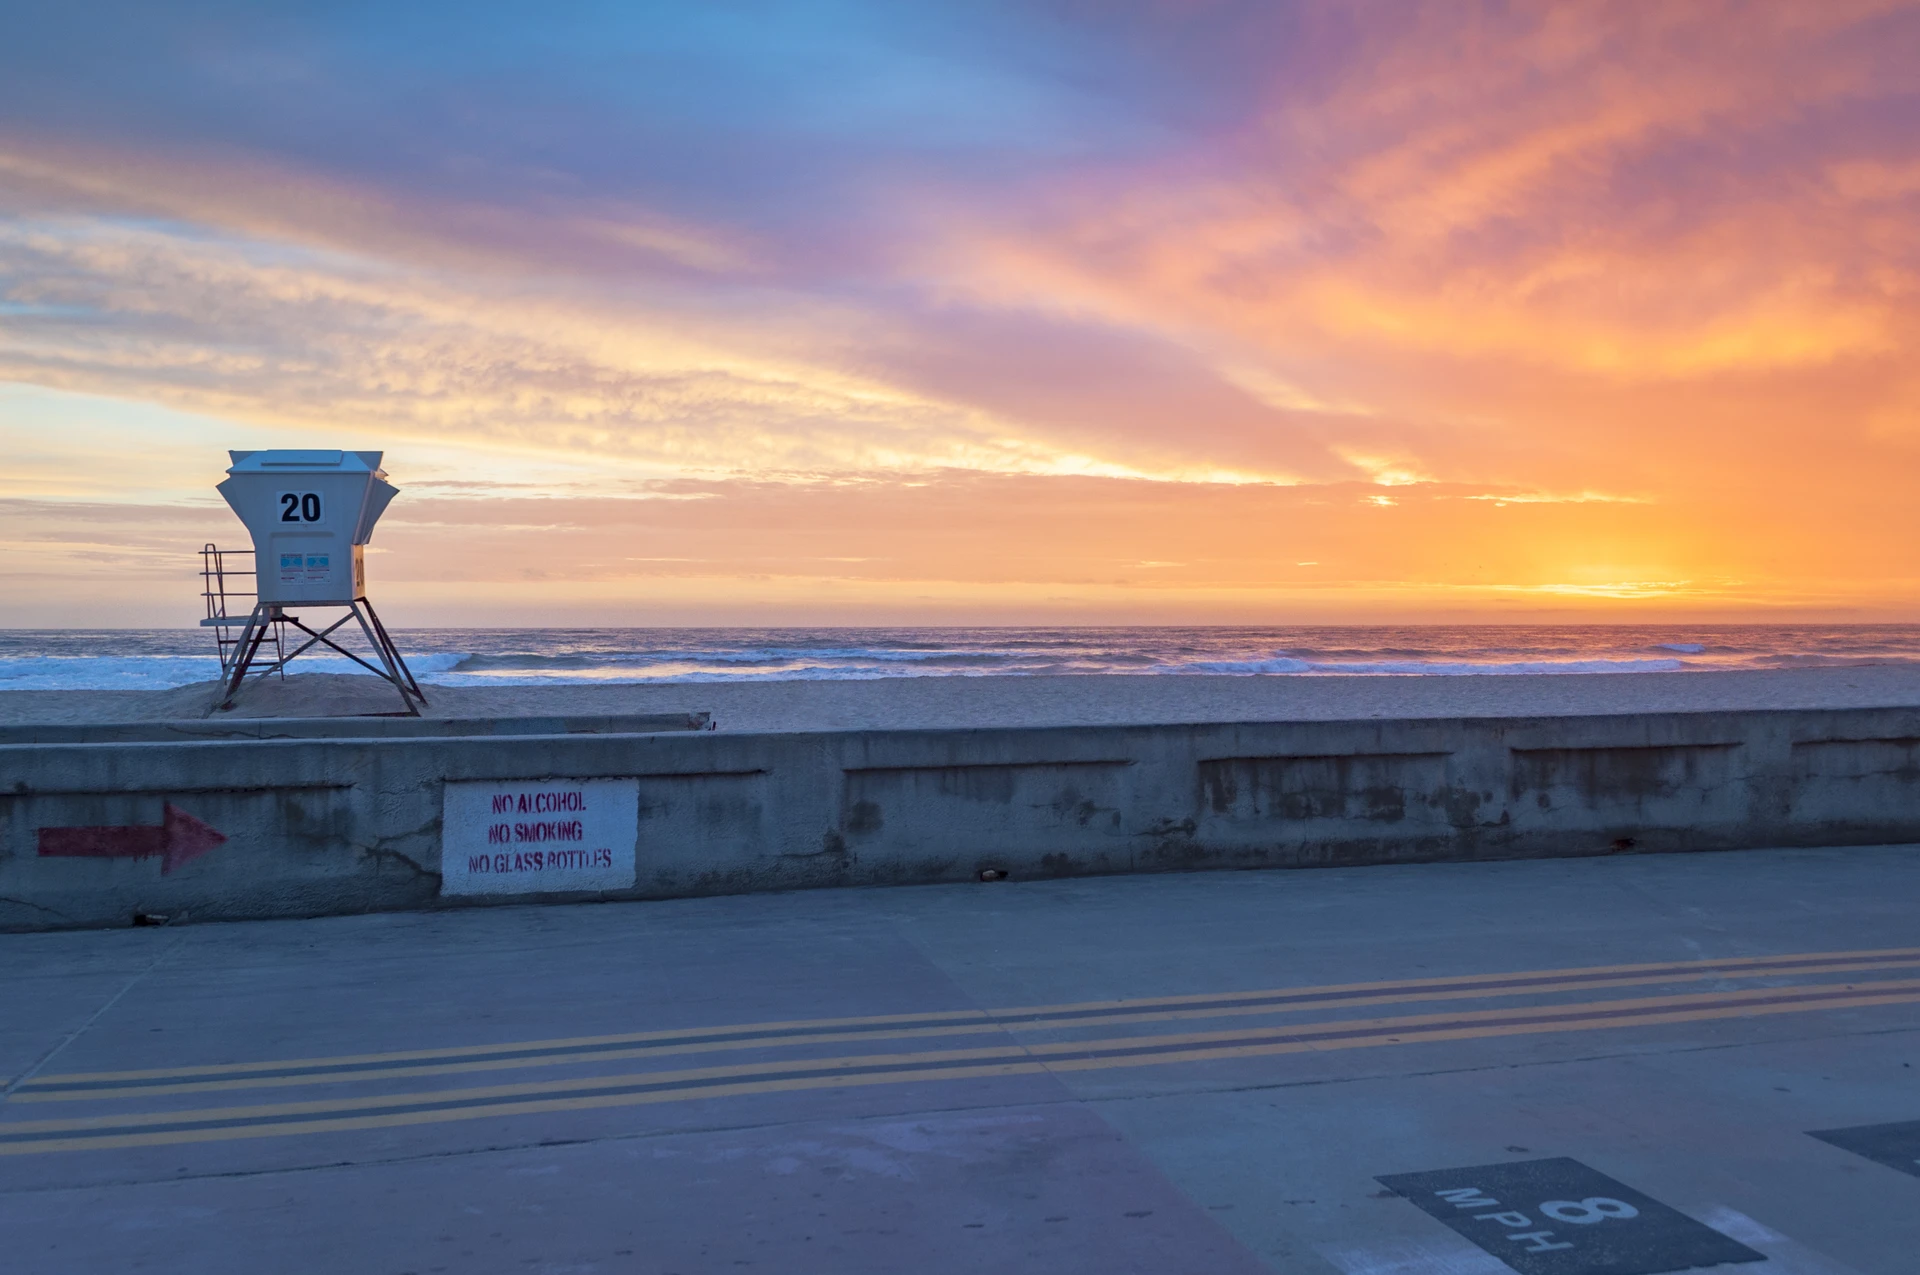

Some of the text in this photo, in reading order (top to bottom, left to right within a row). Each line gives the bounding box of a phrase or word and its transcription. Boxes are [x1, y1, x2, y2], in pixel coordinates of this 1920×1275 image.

[280, 493, 321, 522] 20
[492, 792, 586, 814] NO ALCOHOL
[488, 820, 583, 844] NO SMOKING
[468, 848, 612, 874] NO GLASS BOTTLES
[1434, 1187, 1574, 1252] MPH
[1538, 1197, 1639, 1224] 8
